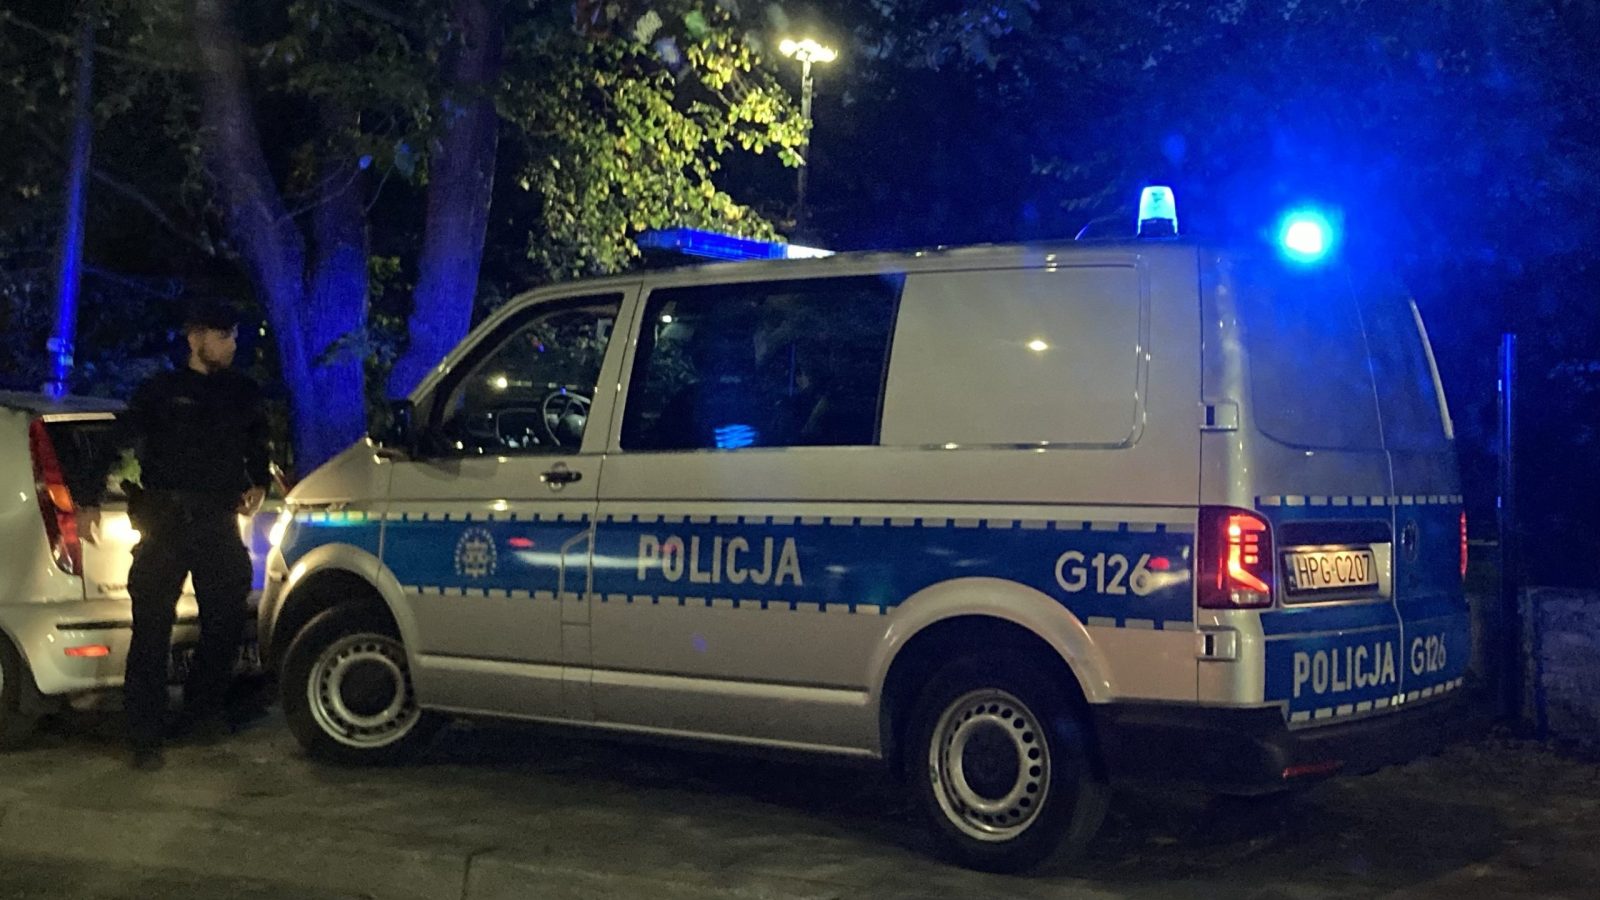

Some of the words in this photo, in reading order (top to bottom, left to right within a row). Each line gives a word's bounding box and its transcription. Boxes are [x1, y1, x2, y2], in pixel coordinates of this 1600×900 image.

[637, 534, 803, 586] POLICJA
[1055, 550, 1153, 596] G126
[1293, 641, 1396, 698] POLICJA
[1410, 632, 1447, 676] G126
